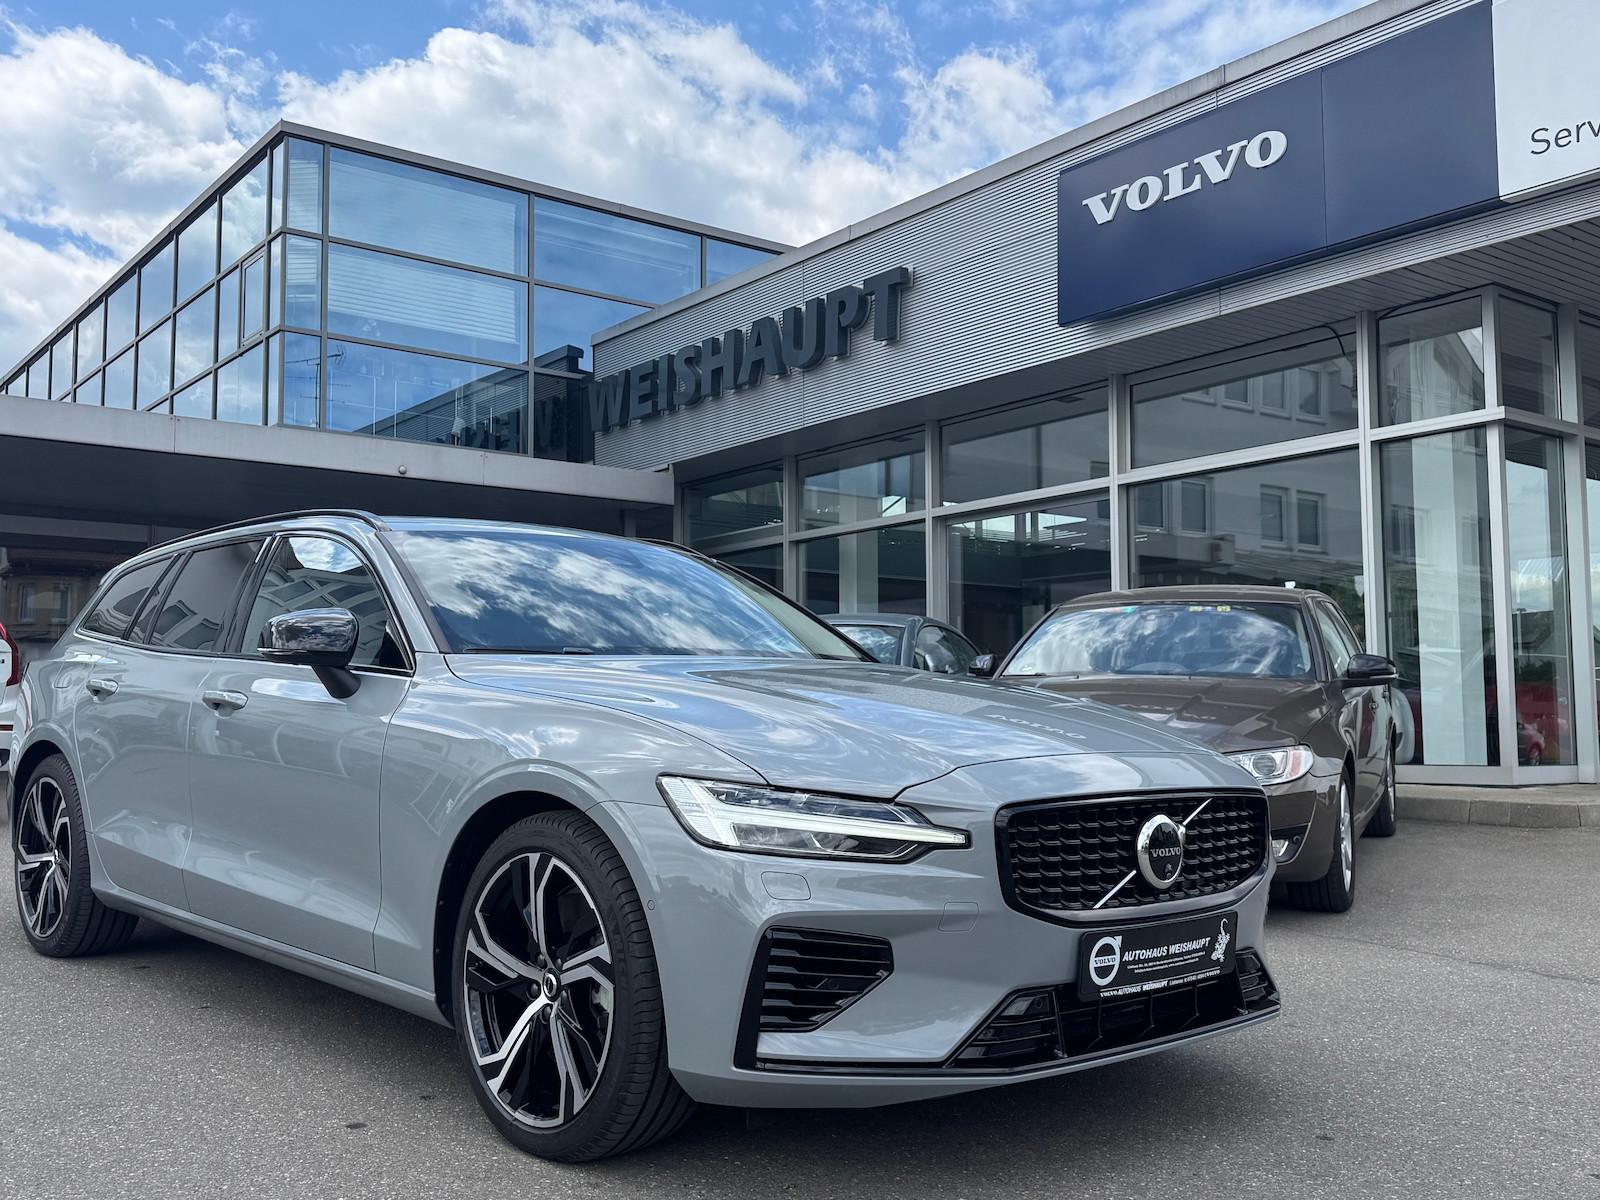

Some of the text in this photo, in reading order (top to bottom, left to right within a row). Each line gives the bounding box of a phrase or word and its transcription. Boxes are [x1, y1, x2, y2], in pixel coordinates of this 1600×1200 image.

[1082, 130, 1288, 226] VOLVO
[588, 265, 912, 433] WEISHAUPT
[1150, 847, 1181, 857] VOLVO
[1122, 945, 1168, 962] AUTOHAUS
[1168, 937, 1211, 955] WEISHAUPT
[1094, 956, 1116, 965] VOLVO
[1117, 985, 1142, 996] AUTOHAUS
[1142, 980, 1169, 992] WEISHAUPT
